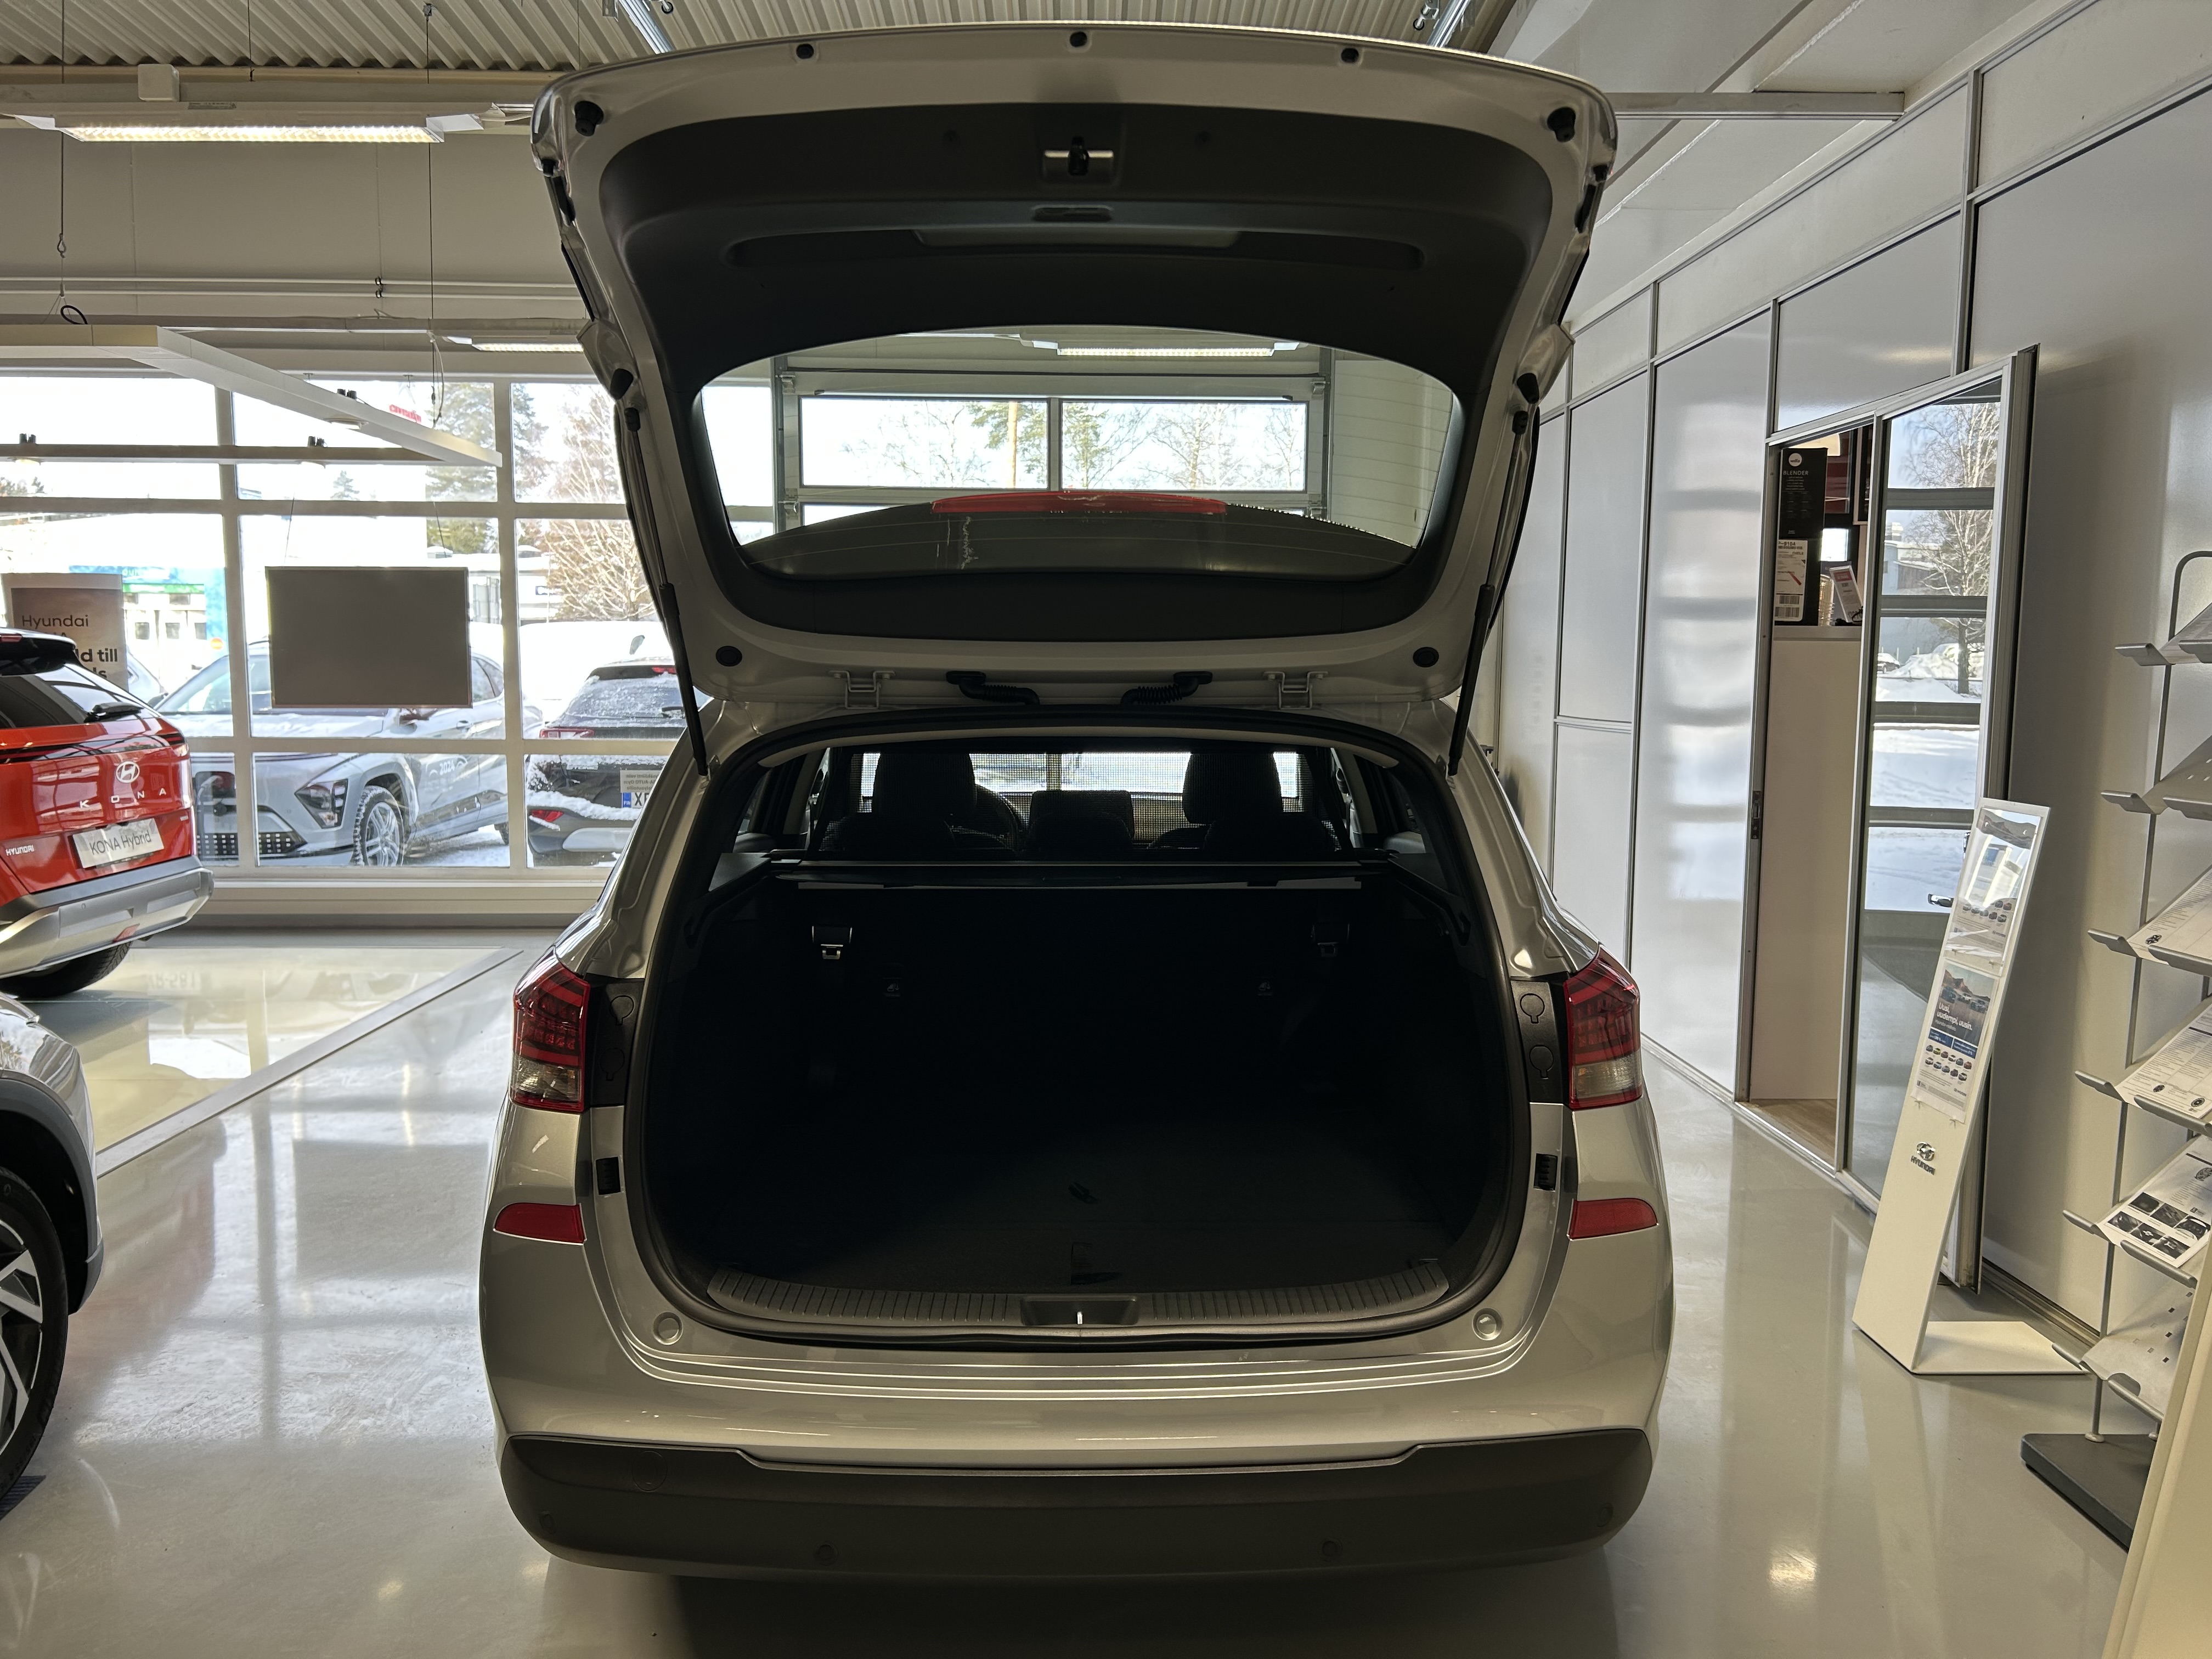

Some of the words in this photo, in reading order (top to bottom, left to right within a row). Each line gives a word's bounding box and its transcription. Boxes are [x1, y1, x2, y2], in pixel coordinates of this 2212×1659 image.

[22, 614, 88, 629] Hyundai
[97, 648, 118, 662] till
[439, 759, 455, 776] 2024
[80, 788, 167, 809] KONA
[5, 844, 35, 856] HYUNDAI
[89, 837, 122, 855] KONA
[120, 830, 152, 849] Hybrid
[1910, 1155, 1936, 1175] HYUNDAI
